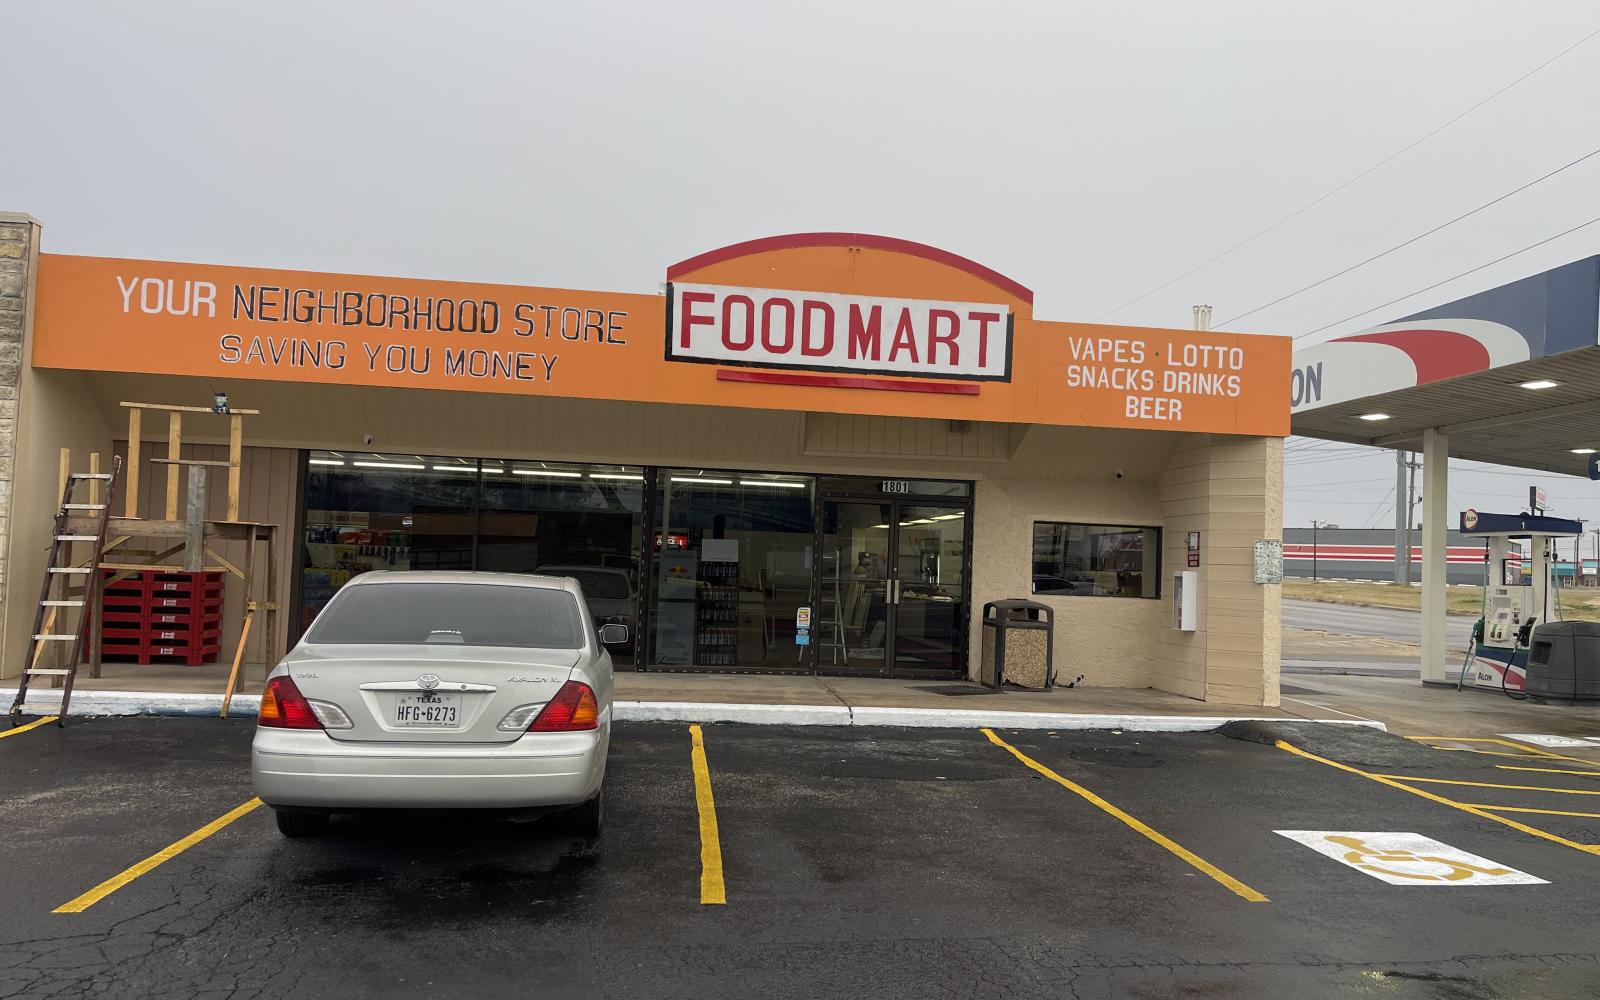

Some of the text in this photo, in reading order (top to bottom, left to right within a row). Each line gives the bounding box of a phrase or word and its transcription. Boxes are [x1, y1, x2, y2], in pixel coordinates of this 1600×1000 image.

[116, 276, 629, 345] YOUR NEIGHBORHOOD STORE
[680, 291, 1001, 368] FOOD MART
[219, 334, 559, 382] SAVING YOU MONEY
[1068, 336, 1244, 370] VAPES LOTTO
[1067, 364, 1241, 397] SNACKS DRINKS
[1125, 395, 1182, 421] BEER
[883, 481, 907, 492] 1801
[416, 696, 442, 704] TEXAS
